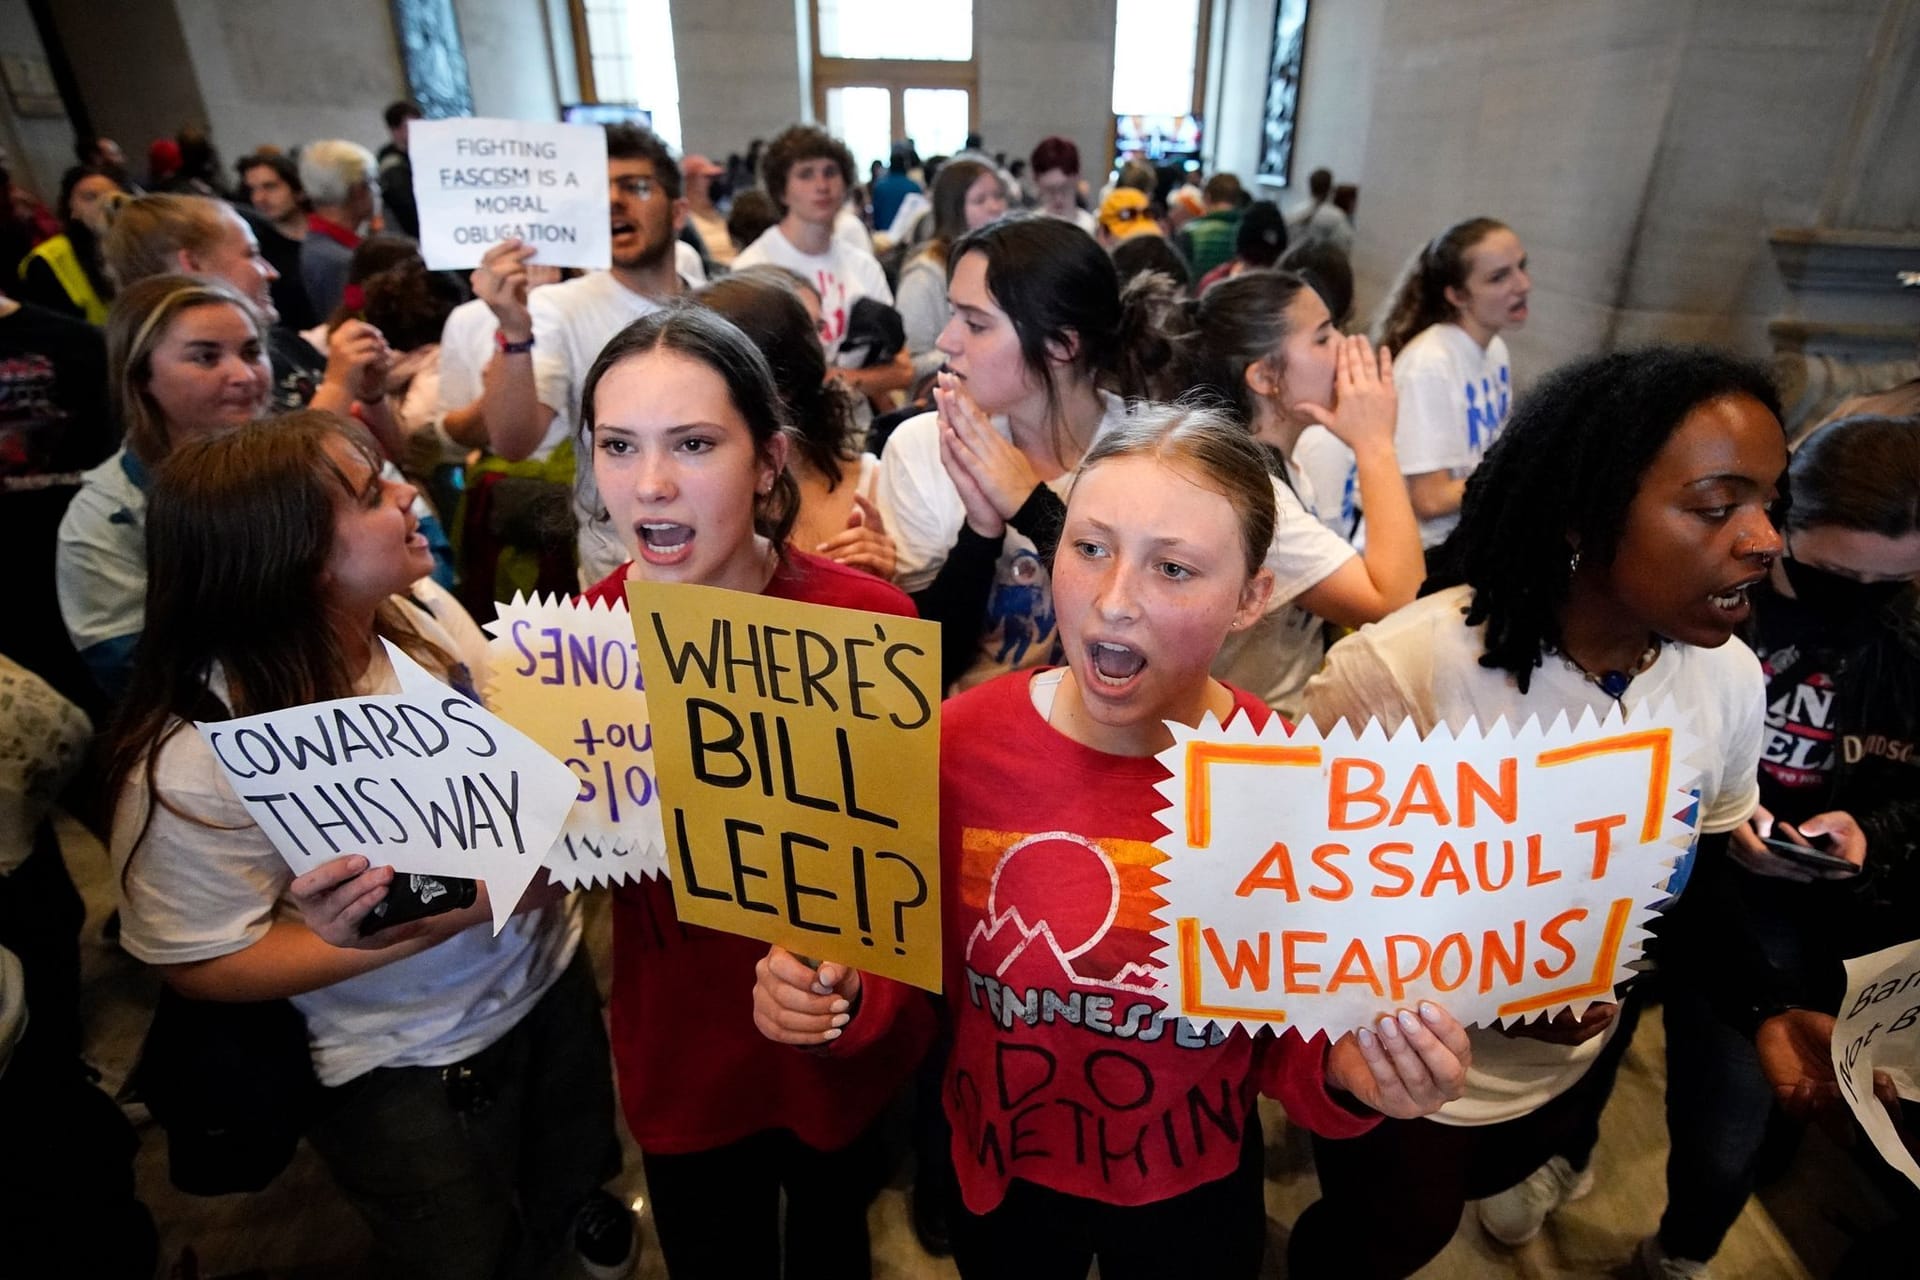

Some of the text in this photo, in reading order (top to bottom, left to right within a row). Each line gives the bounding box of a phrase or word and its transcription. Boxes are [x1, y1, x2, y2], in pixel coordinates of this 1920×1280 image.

[439, 168, 580, 187] FASCISM IS A
[456, 138, 557, 159] FIGHTING
[453, 224, 577, 244] OBLIGATION
[475, 197, 548, 214] MORAL
[651, 612, 931, 730] WHERE'S
[211, 698, 497, 778] COWARDS
[686, 698, 899, 829] BILL
[243, 770, 526, 856] THIS WAY
[1327, 757, 1518, 831] BAN
[674, 808, 927, 956] LEE!?
[1235, 814, 1627, 903] ASSAULT
[1202, 908, 1588, 1000] WEAPONS
[965, 966, 1229, 1049] TENNESSE
[996, 1040, 1155, 1111] DO
